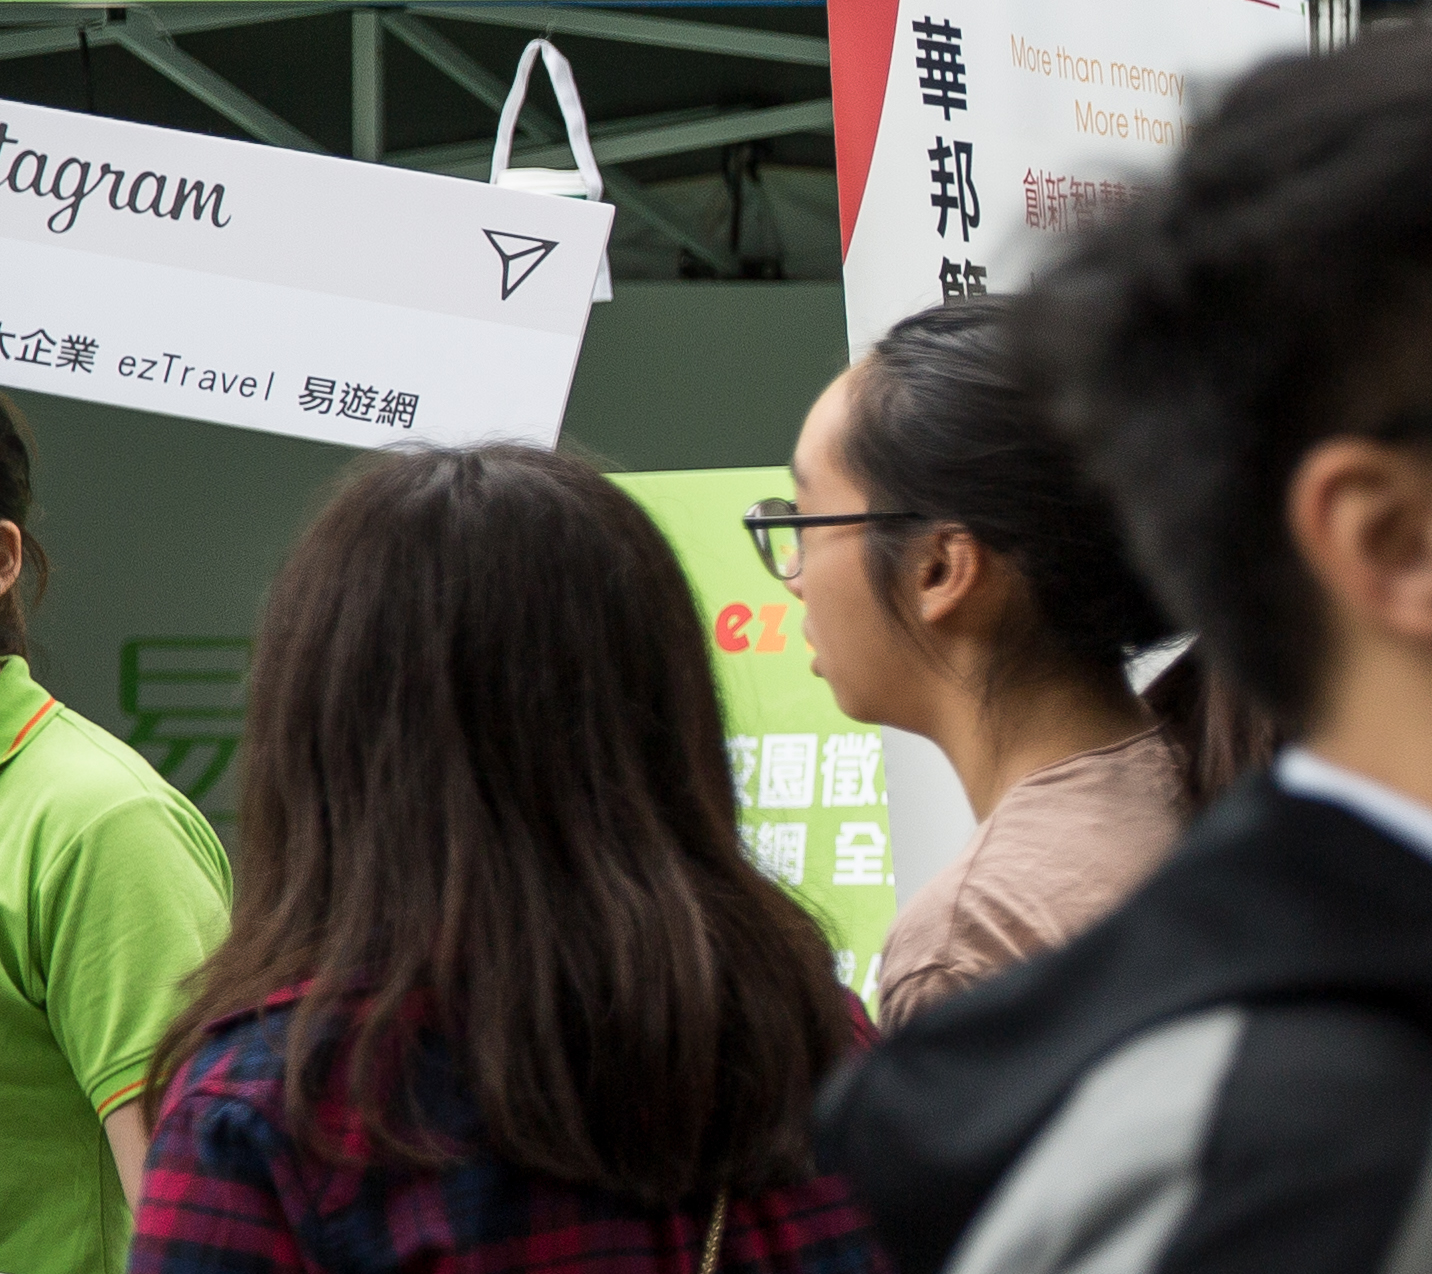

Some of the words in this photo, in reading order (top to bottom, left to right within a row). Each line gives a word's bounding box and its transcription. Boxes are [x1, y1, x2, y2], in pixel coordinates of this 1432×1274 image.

[1010, 32, 1052, 76] More
[1056, 45, 1104, 84] than
[1109, 60, 1185, 107] memory
[1074, 98, 1129, 138] More
[1134, 108, 1175, 147] than
[117, 352, 274, 402] ezTravel
[298, 374, 420, 430] 易遊網
